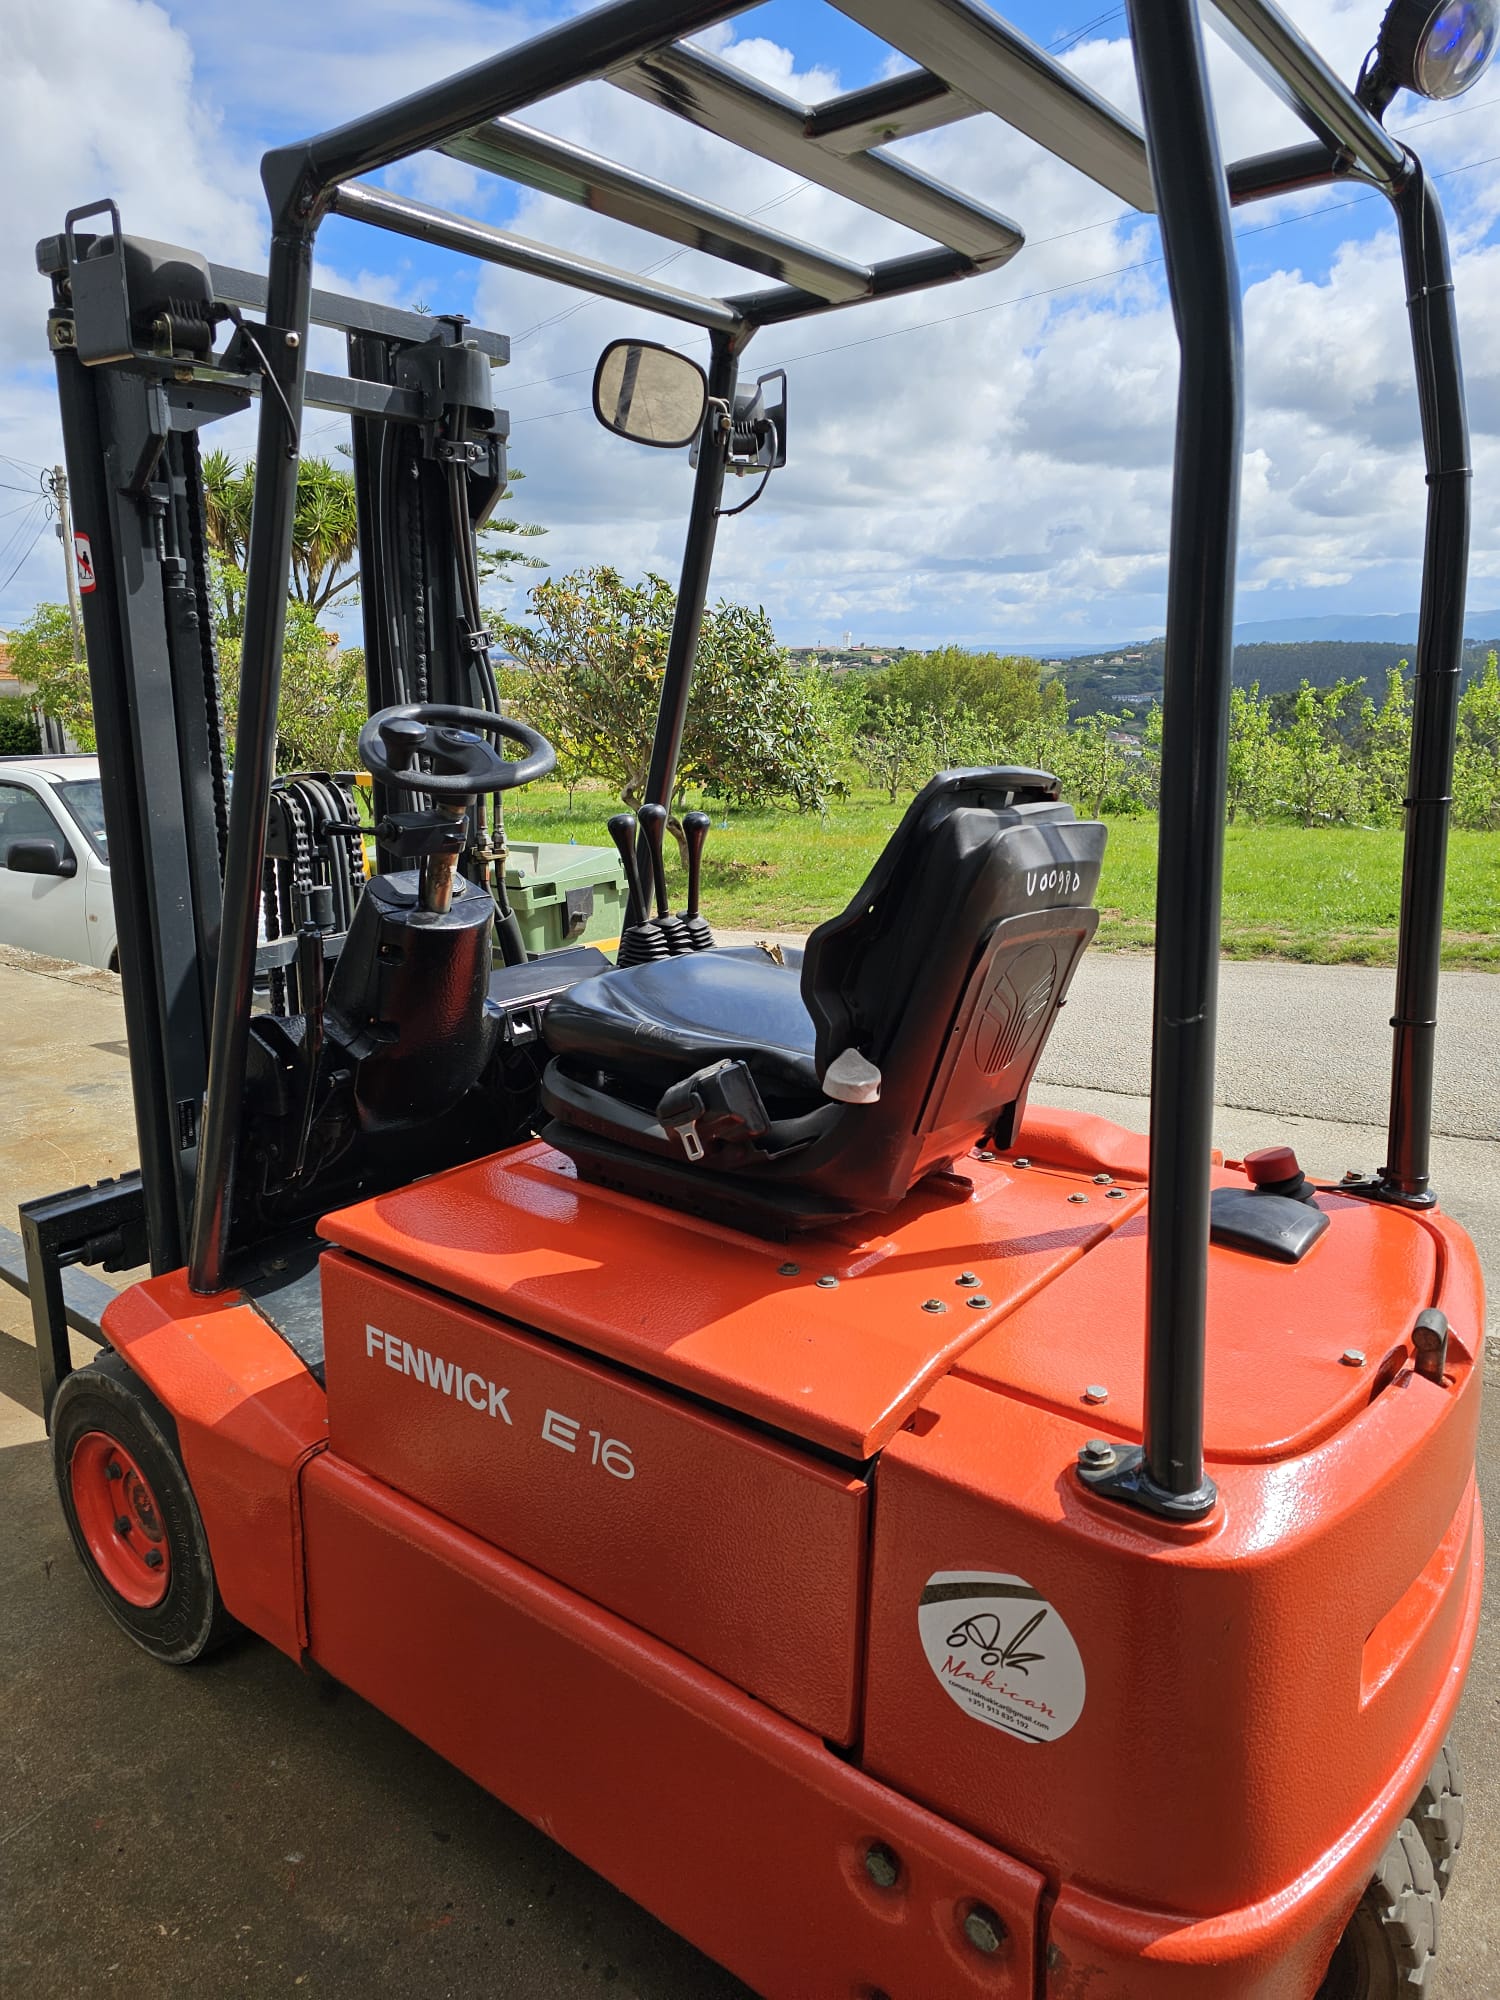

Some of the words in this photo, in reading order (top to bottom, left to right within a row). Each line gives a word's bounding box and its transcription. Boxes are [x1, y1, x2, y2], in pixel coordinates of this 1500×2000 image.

[365, 1323, 513, 1426] FENWICK
[947, 1679, 1050, 1731] comercialmakicar@gmail.com
[968, 1697, 985, 1709] +351
[986, 1704, 1000, 1715] 913
[1016, 1719, 1029, 1729] 192
